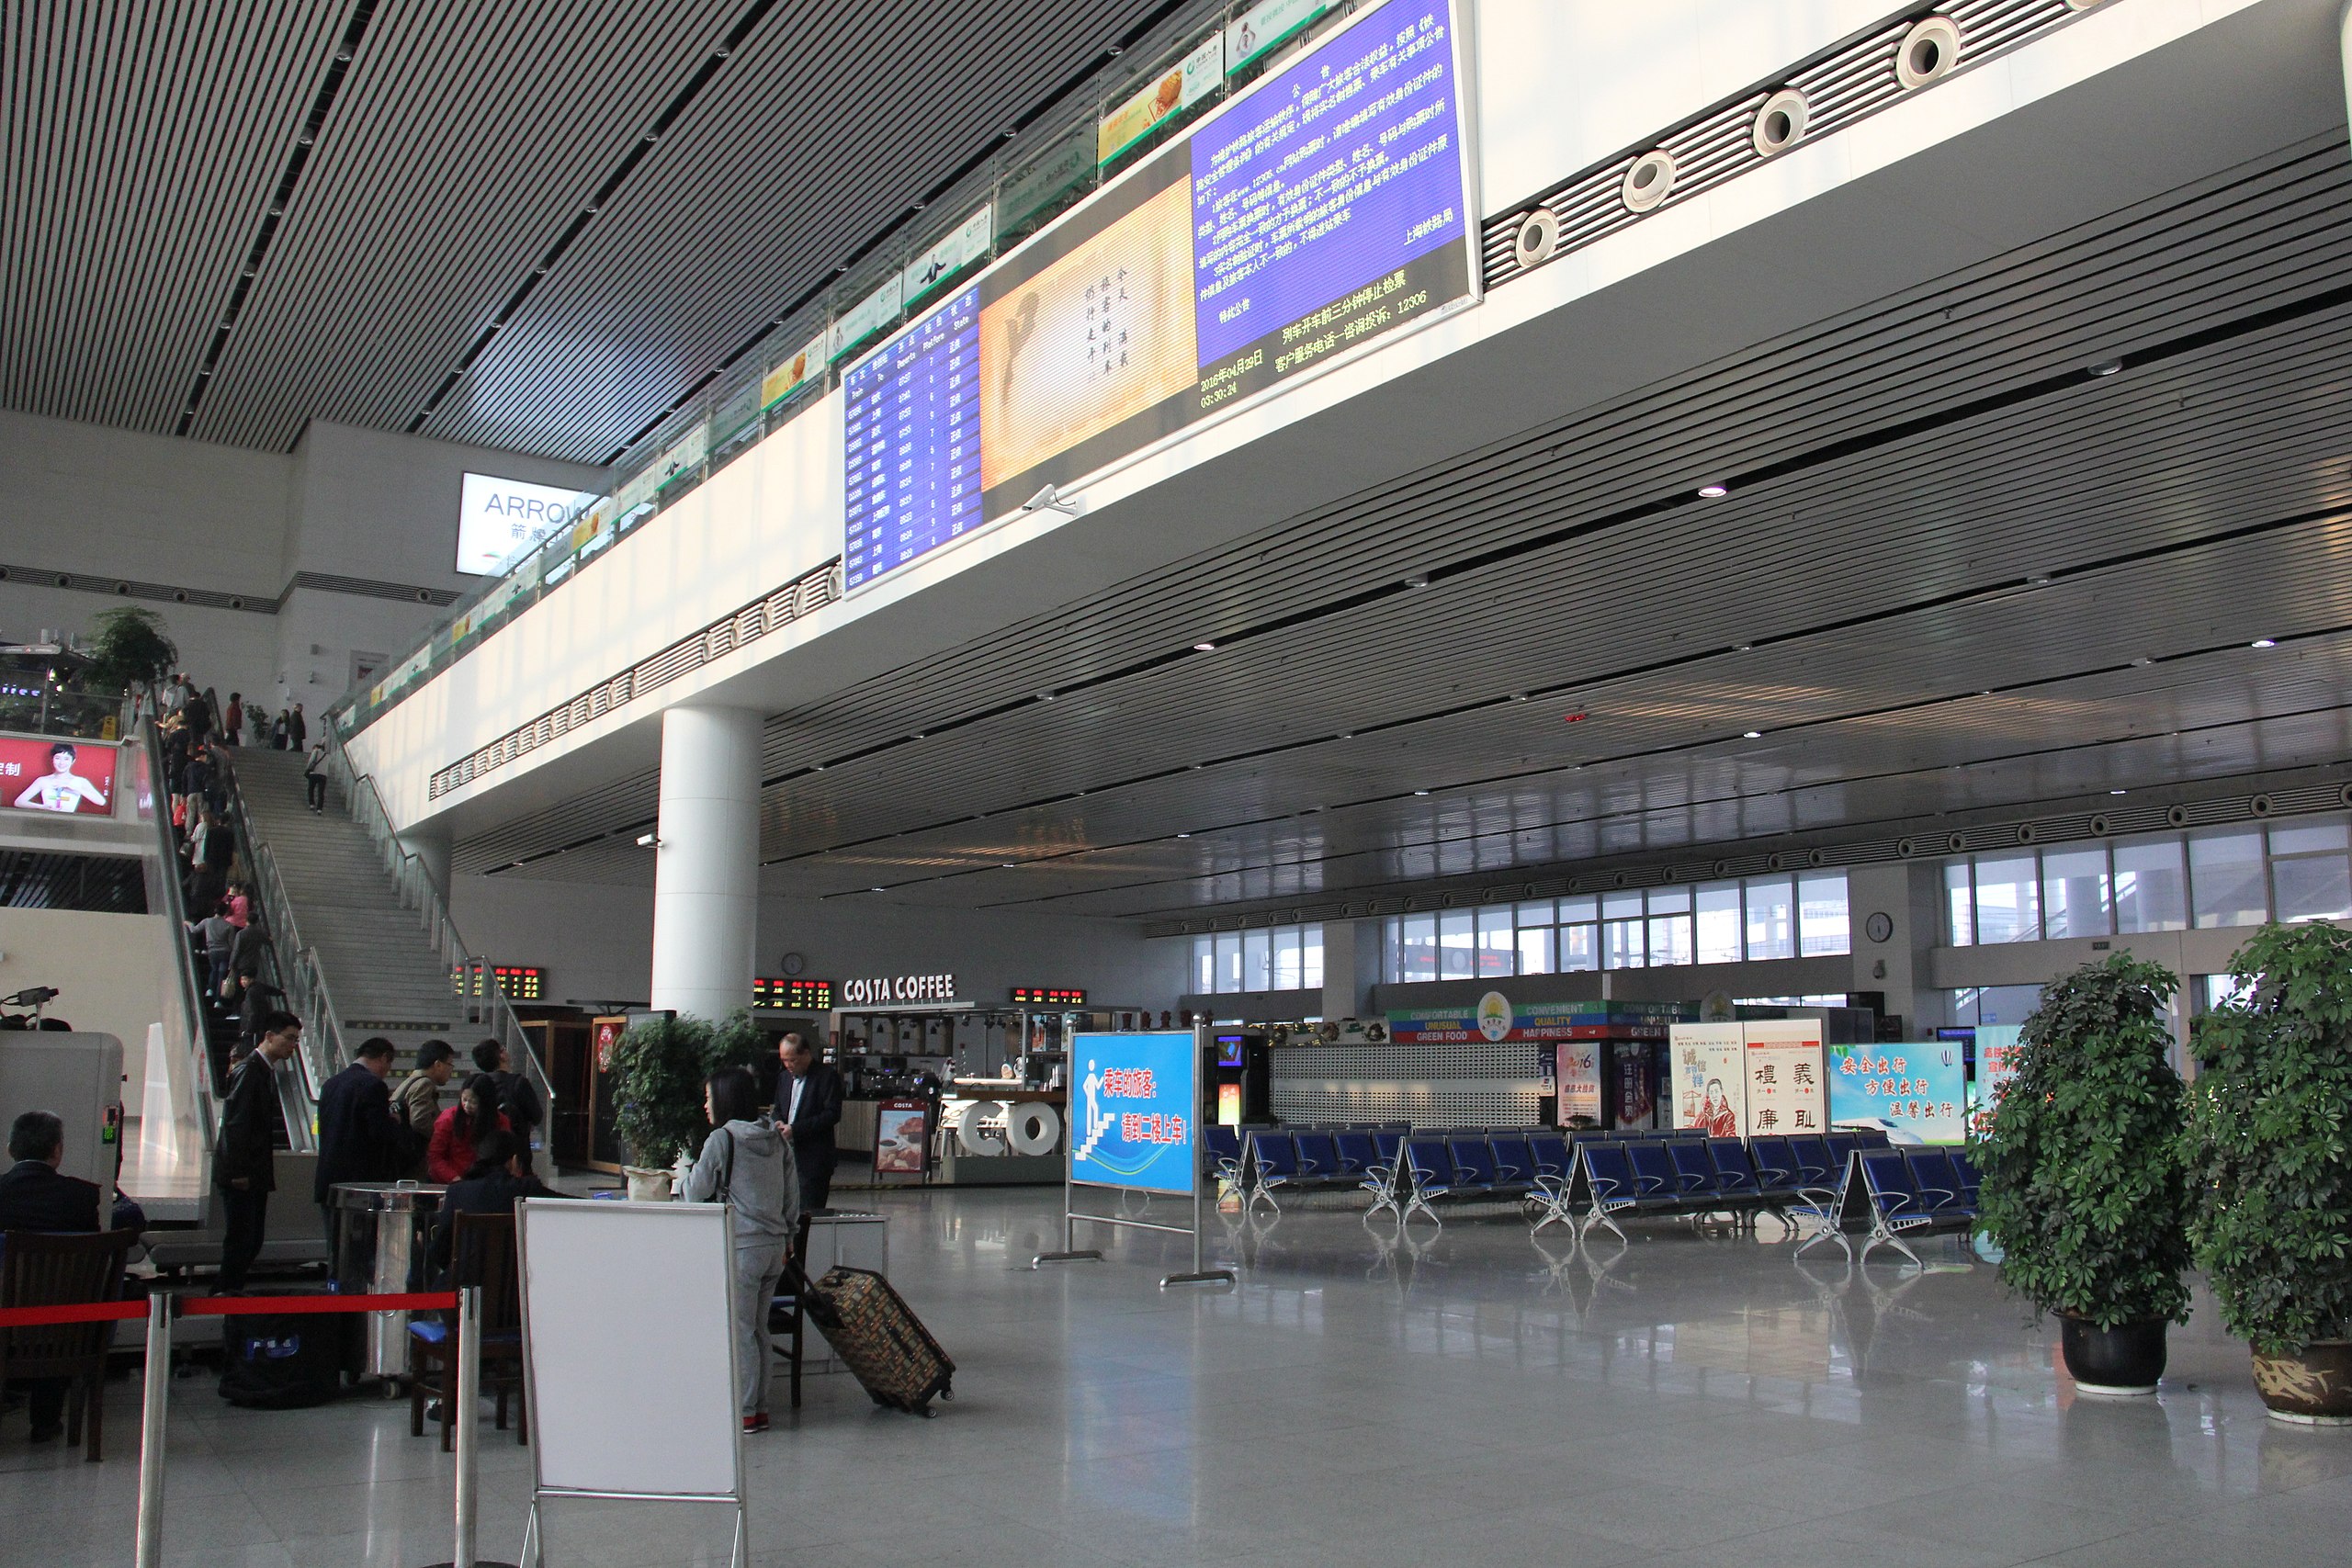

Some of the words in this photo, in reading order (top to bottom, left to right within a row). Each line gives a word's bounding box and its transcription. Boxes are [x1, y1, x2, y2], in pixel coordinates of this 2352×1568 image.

[1402, 207, 1453, 247] 上海铁路局
[1283, 269, 1406, 344] 列车开车前三分钟停止检票
[1397, 290, 1427, 314] 12306
[953, 312, 968, 332] State
[843, 978, 891, 1003] COSTA
[895, 974, 955, 999] COFFEE
[1410, 1009, 1469, 1021] COMFORTABLE
[1526, 1003, 1584, 1016] CONVENIENT
[1425, 1021, 1462, 1031] UNUSUAL
[1533, 1016, 1572, 1027] QUALITY
[1417, 1031, 1443, 1042] GREEN
[1445, 1030, 1468, 1041] FOOD
[1522, 1026, 1573, 1038] HAPPINESS
[1793, 1063, 1815, 1085] 義
[1839, 1055, 1907, 1075] 安全出行
[1865, 1078, 1929, 1096] 方便出行
[1757, 1109, 1779, 1130] 廉
[1889, 1101, 1954, 1120] 温馨出行
